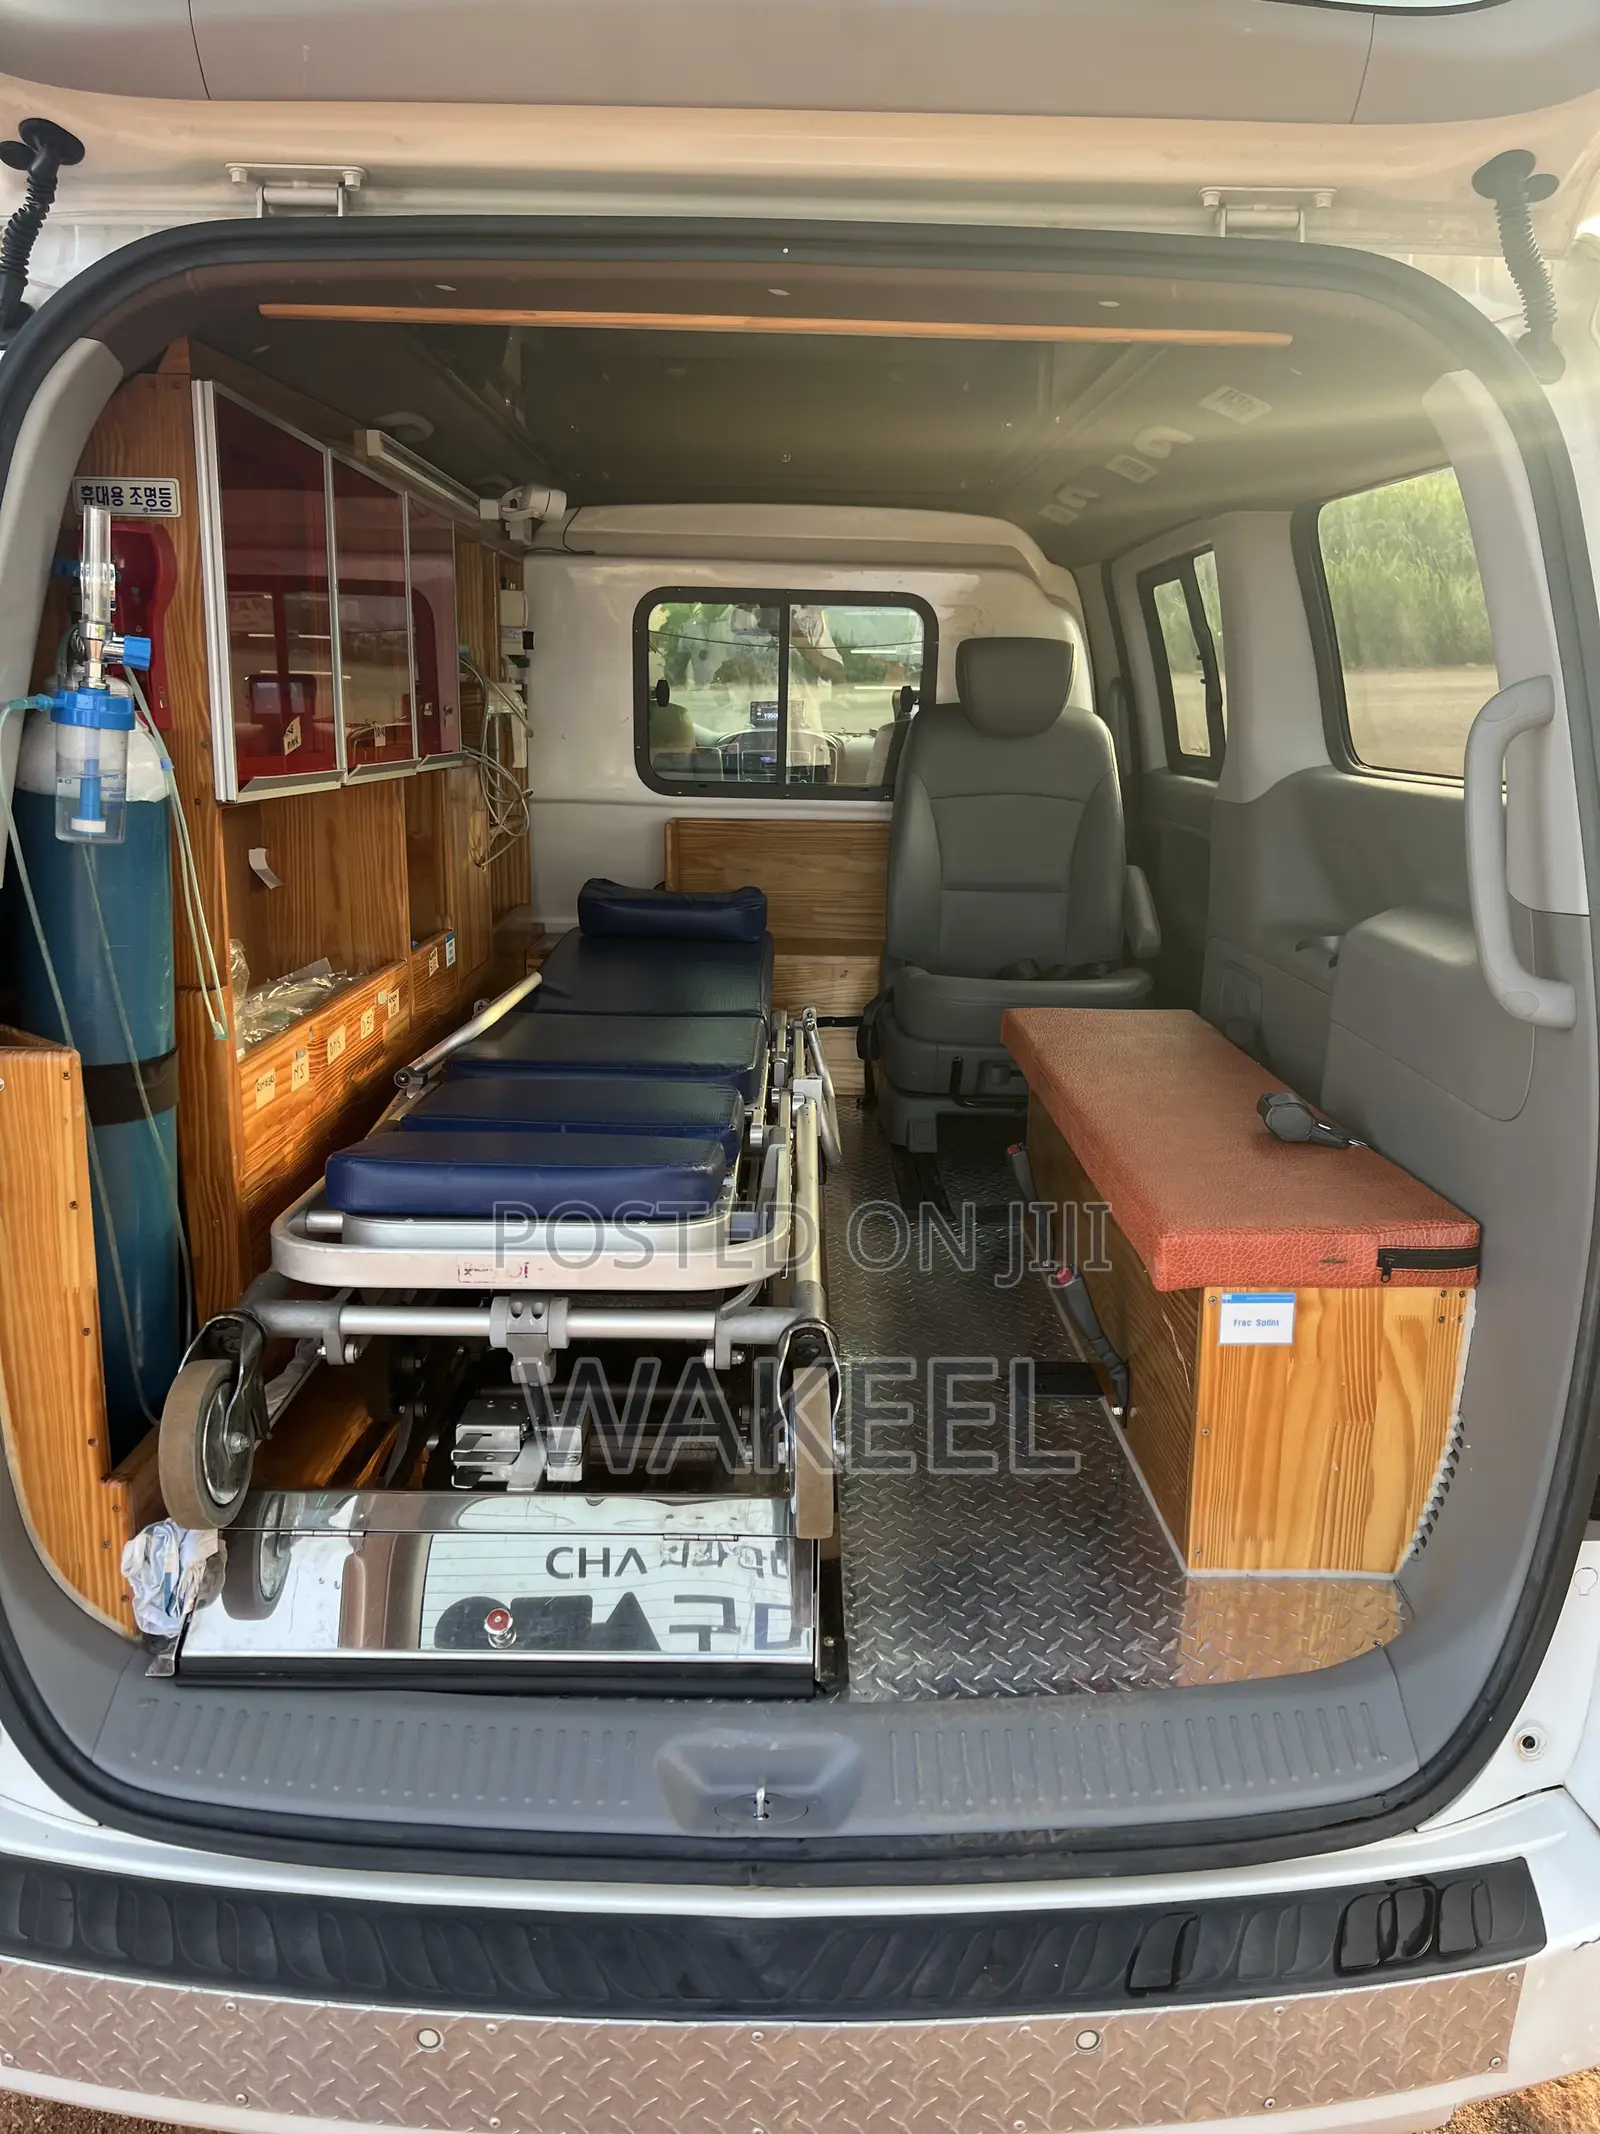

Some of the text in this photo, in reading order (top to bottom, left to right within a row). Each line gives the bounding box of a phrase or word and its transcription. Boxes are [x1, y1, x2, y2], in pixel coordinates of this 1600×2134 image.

[80, 485, 172, 508] 휴대용 조명등
[1233, 1318, 1279, 1327] Frac Splint
